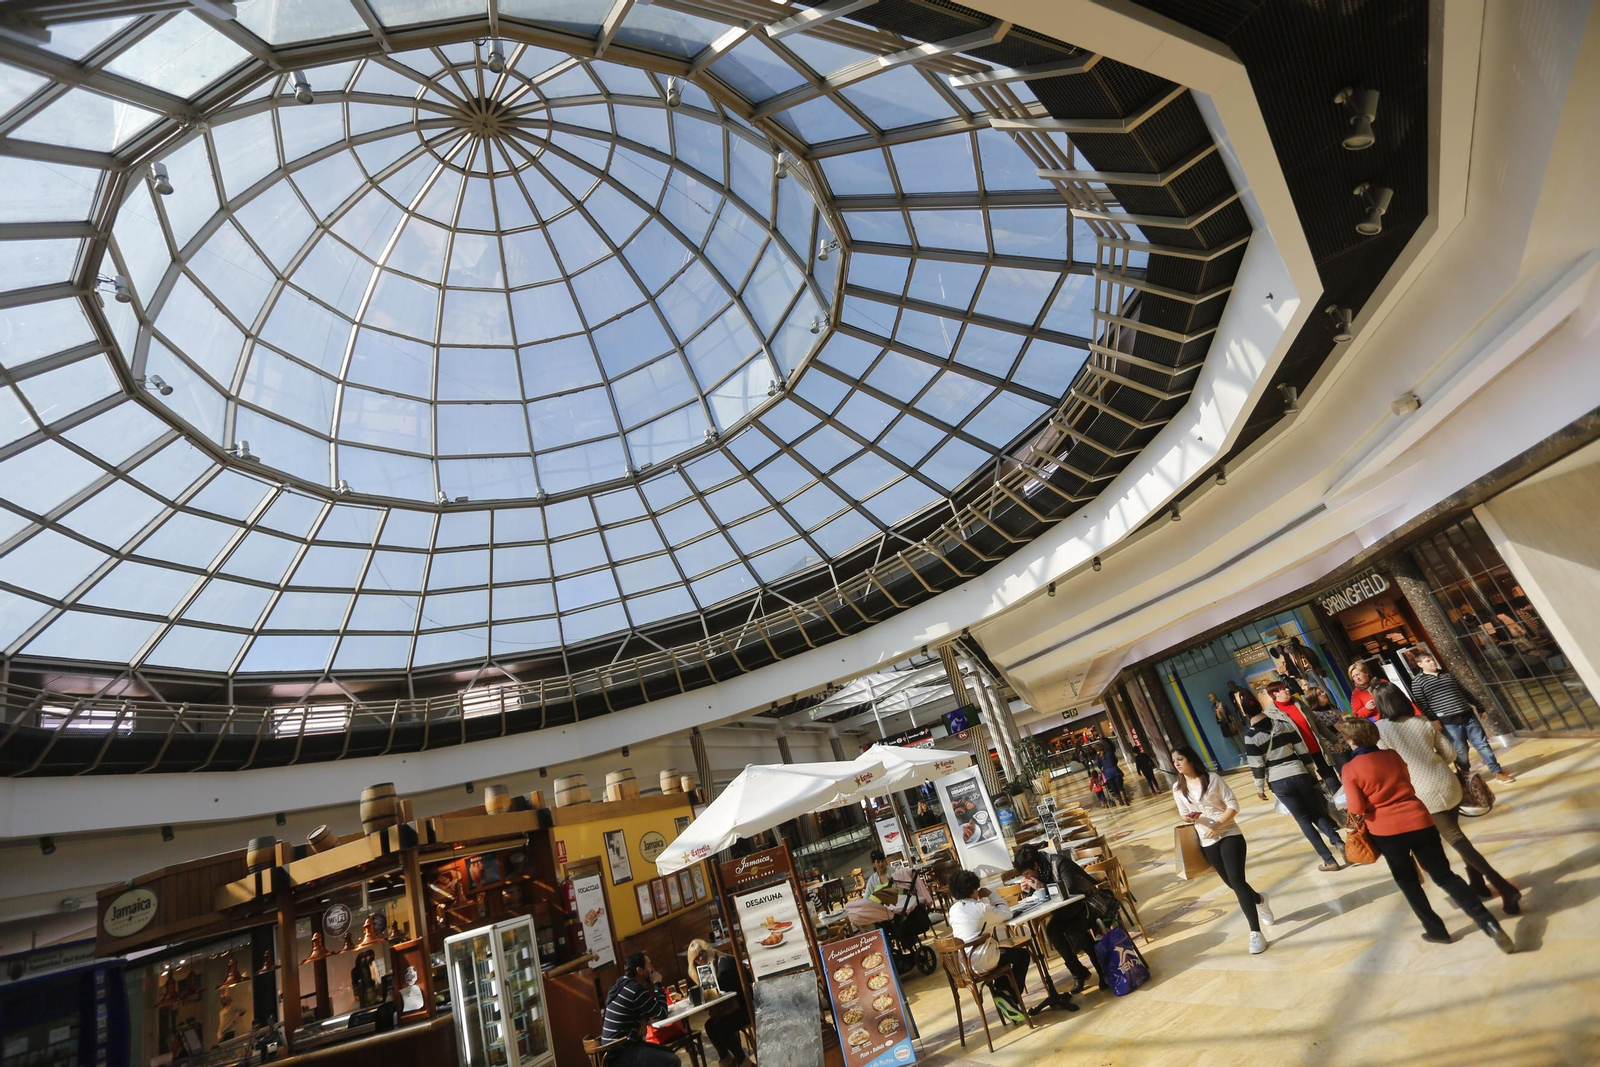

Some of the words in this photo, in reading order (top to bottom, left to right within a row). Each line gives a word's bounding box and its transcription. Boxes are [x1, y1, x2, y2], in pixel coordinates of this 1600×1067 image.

[1321, 573, 1386, 616] SPRINGFIELD
[643, 838, 665, 852] Jamaica
[690, 844, 711, 857] Estrella
[735, 855, 771, 875] Jamaica
[761, 869, 775, 877] SHOP
[745, 892, 784, 908] DESAYUNA
[110, 898, 151, 921] Jamaica
